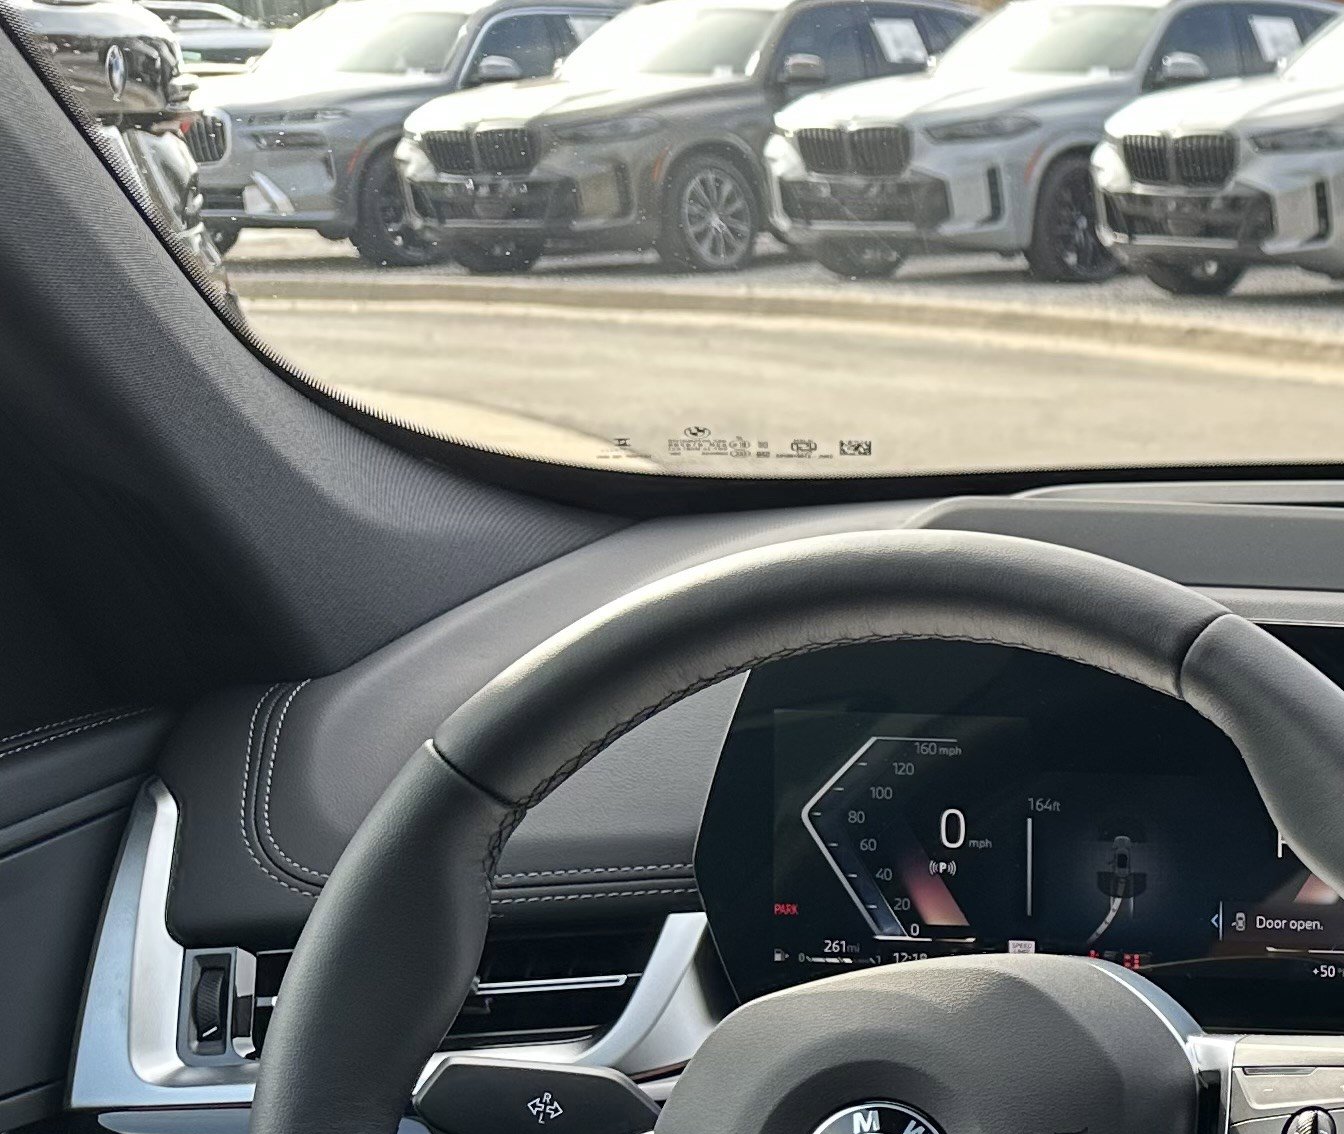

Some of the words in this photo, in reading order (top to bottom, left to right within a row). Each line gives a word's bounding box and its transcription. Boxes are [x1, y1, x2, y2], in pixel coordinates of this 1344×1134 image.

[914, 742, 937, 755] 160
[939, 745, 962, 756] mph
[892, 762, 915, 775] 120
[869, 786, 893, 800] 100
[847, 810, 865, 824] 80
[940, 808, 966, 849] 0
[968, 839, 993, 849] mph
[859, 838, 877, 851] 60
[875, 868, 893, 881] 40
[774, 903, 799, 916] PARK
[893, 897, 911, 911] 20
[1255, 915, 1287, 929] Door
[910, 923, 920, 937] 0
